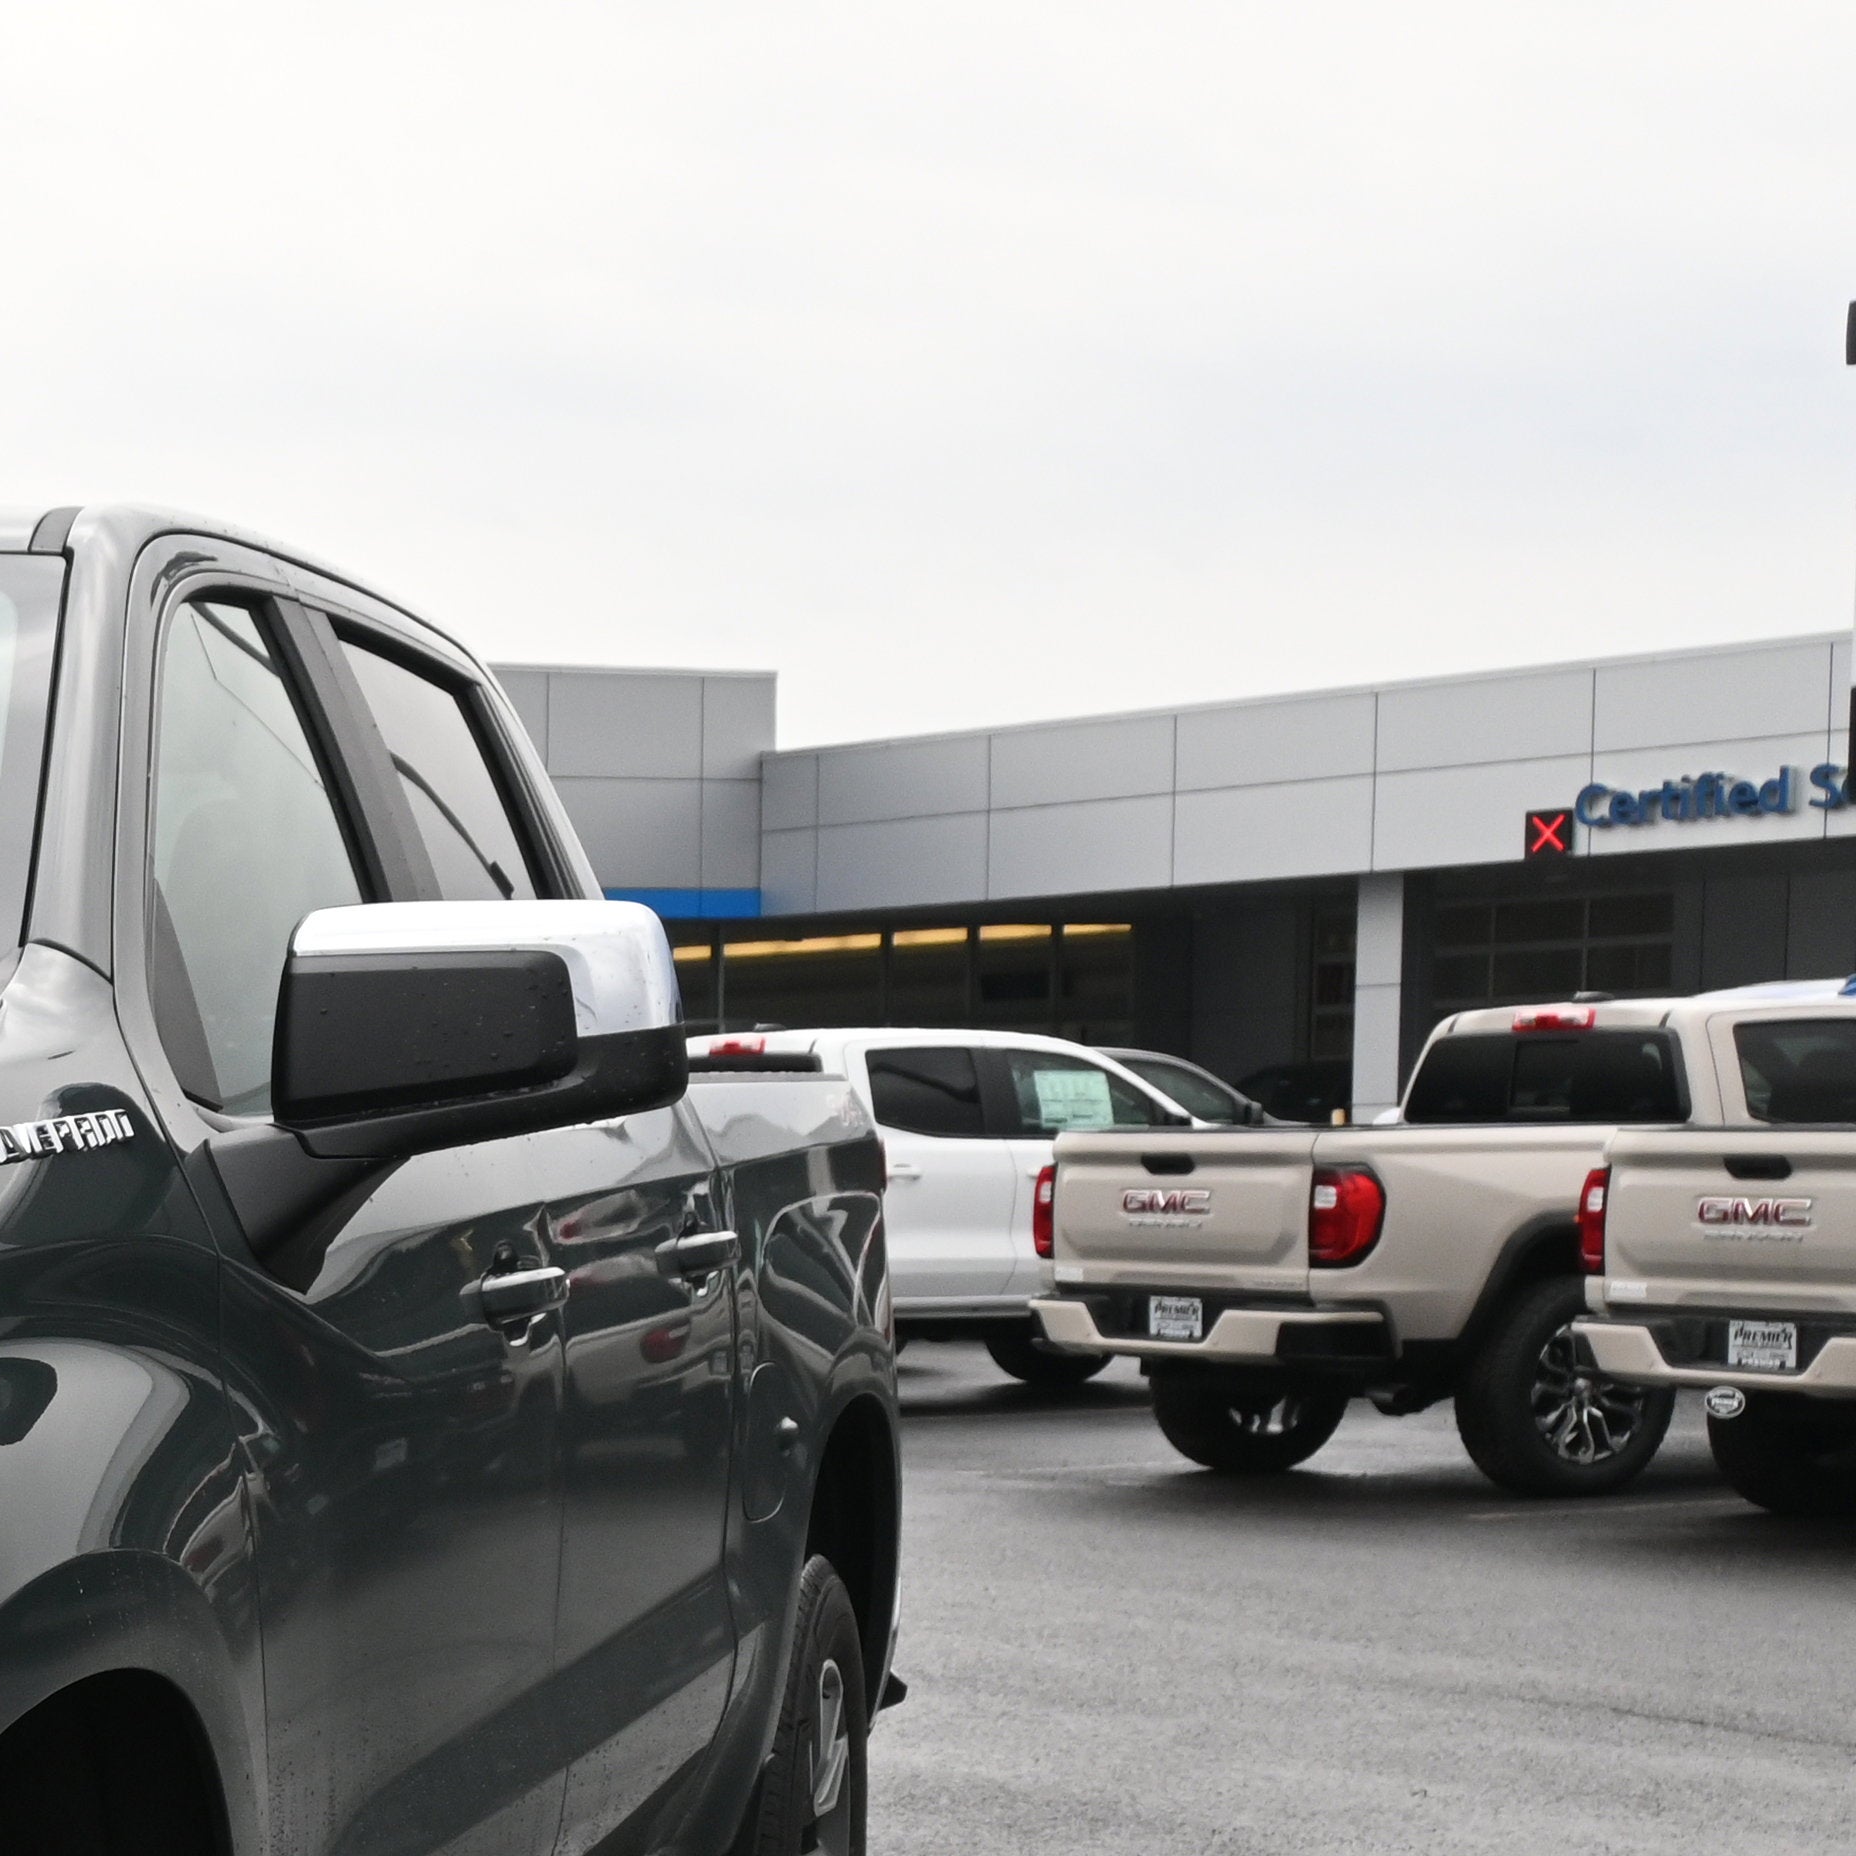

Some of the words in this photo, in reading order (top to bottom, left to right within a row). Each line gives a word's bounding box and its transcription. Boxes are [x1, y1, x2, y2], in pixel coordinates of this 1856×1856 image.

[1574, 764, 1796, 828] Certified
[1122, 1188, 1212, 1215] GMC
[1698, 1196, 1813, 1226] GMC
